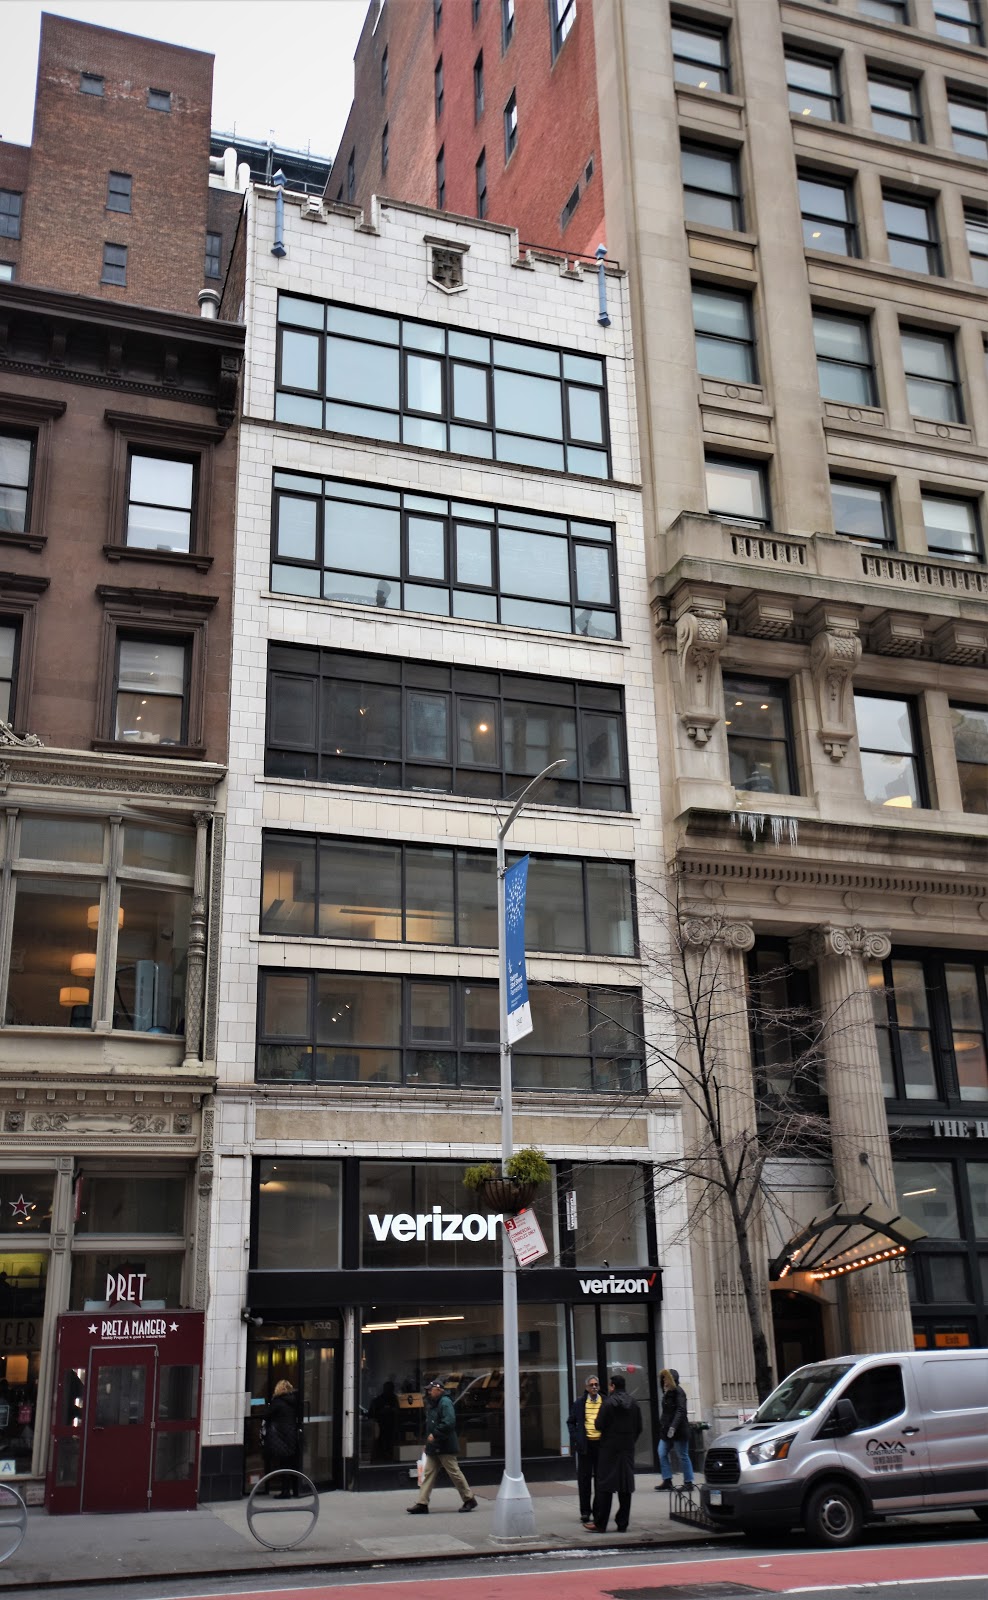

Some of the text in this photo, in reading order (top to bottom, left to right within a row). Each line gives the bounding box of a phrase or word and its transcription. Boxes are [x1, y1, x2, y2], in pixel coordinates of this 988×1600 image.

[930, 1120, 970, 1138] THE
[105, 1272, 147, 1302] PRET
[579, 1274, 649, 1294] verizon
[0, 1321, 36, 1346] GER
[101, 1319, 166, 1336] PRET A MANGER
[866, 1438, 906, 1450] CAVA
[866, 1448, 908, 1457] CONSTRUCTION
[2, 1462, 12, 1472] A
